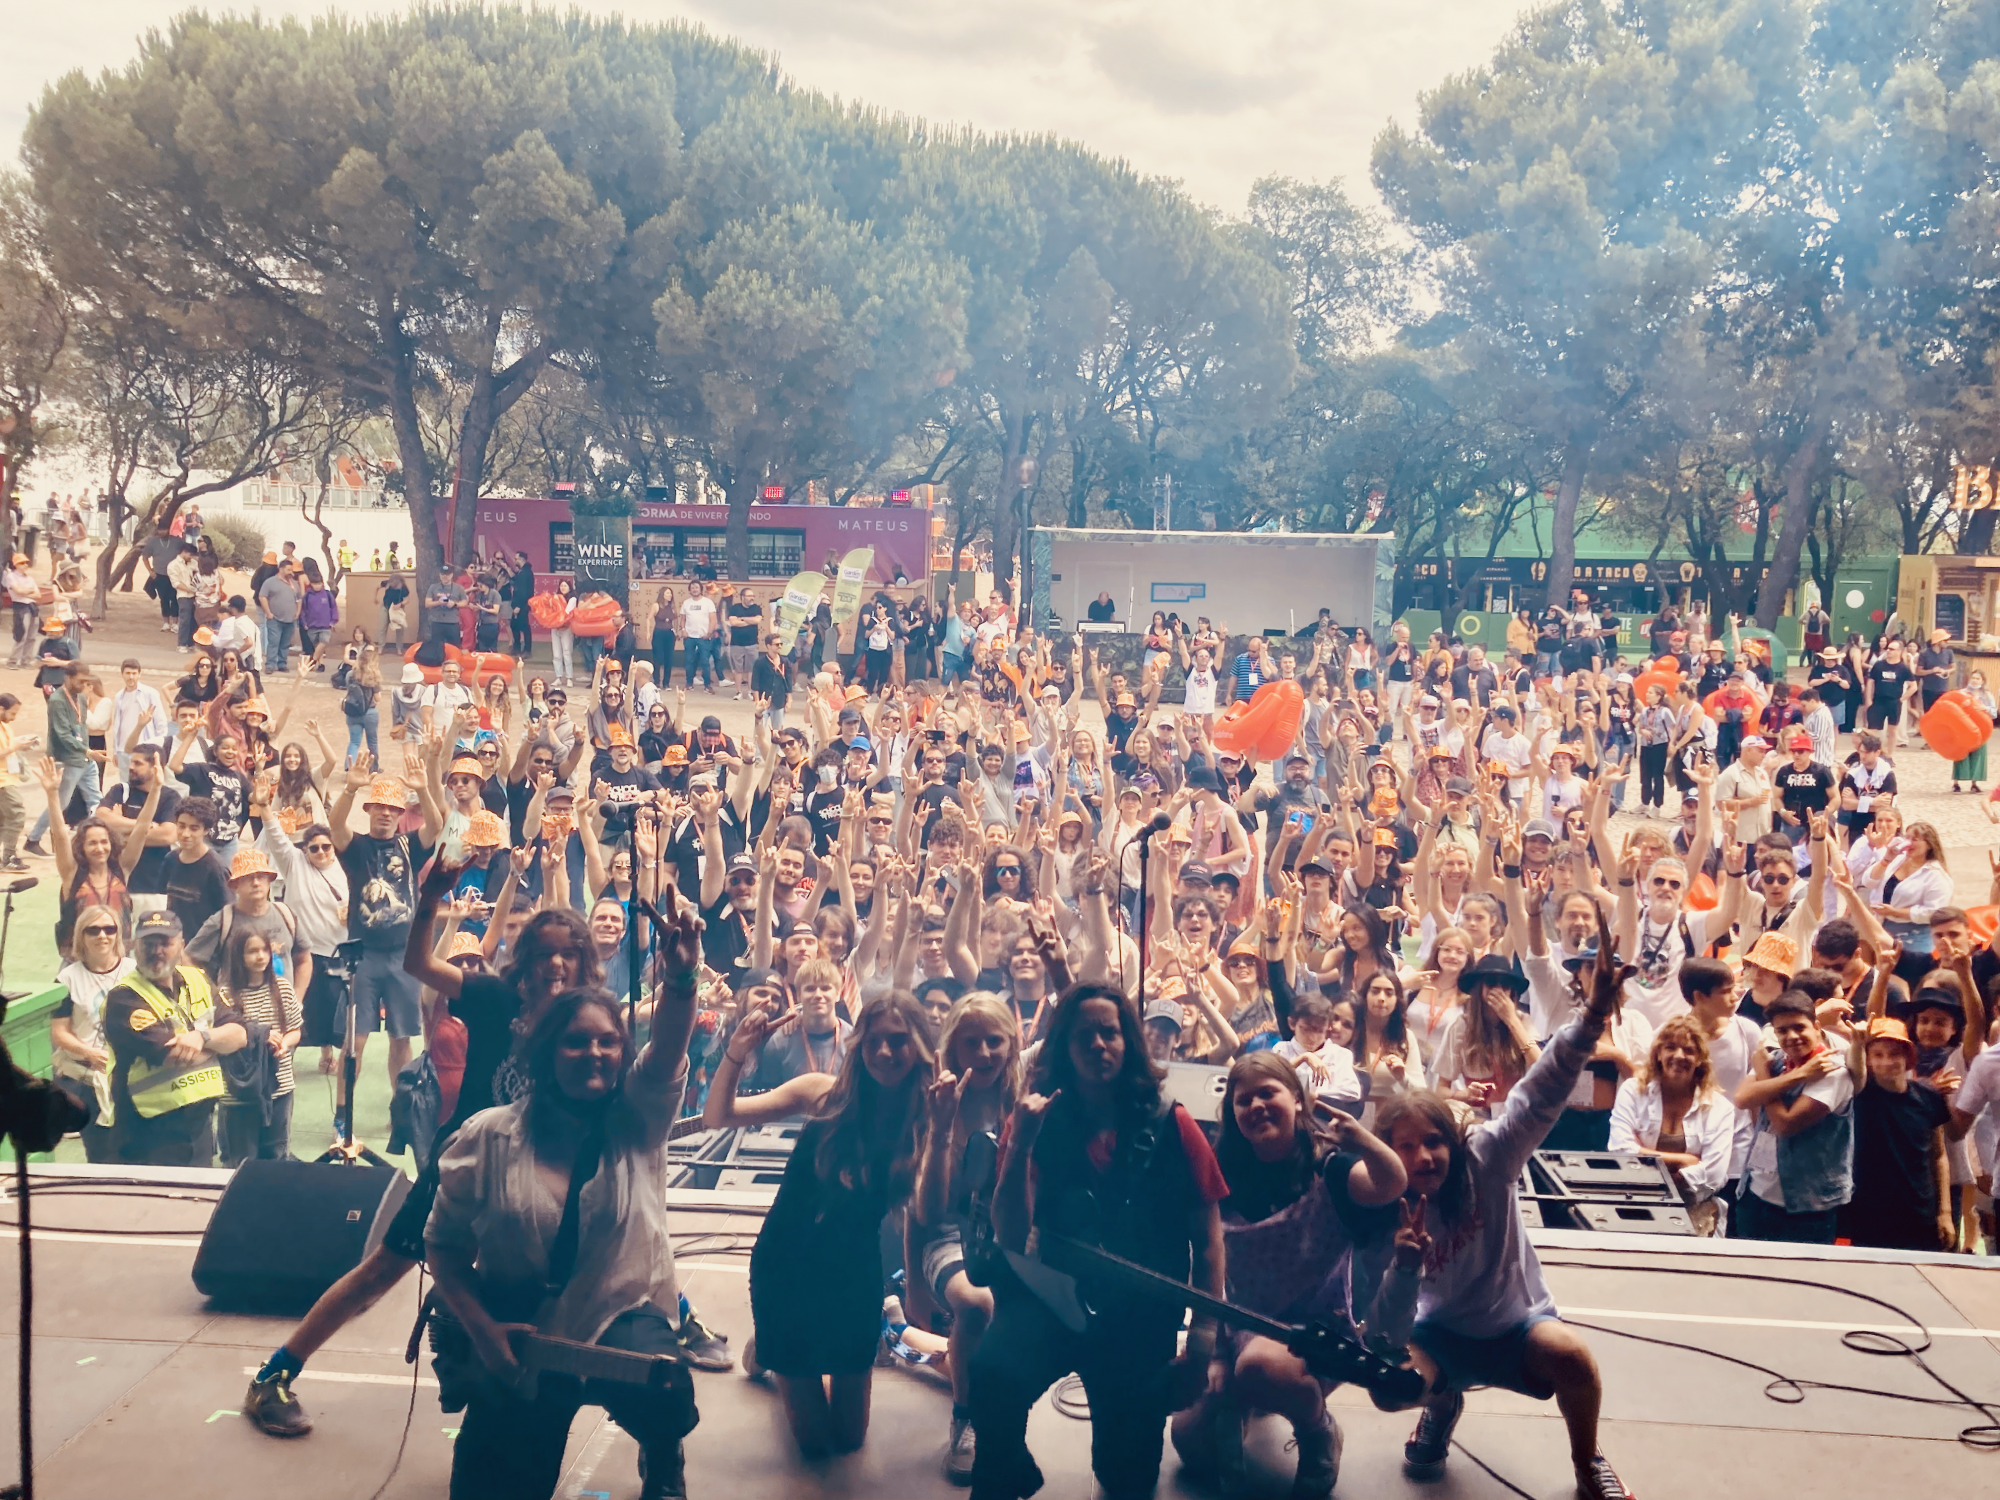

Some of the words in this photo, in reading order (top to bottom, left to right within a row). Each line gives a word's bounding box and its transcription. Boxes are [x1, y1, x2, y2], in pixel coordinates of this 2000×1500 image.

[640, 508, 678, 518] ORMA
[681, 511, 693, 519] DE
[695, 511, 722, 520] VIVER
[749, 513, 771, 521] NDO
[838, 520, 909, 532] MATEUS
[577, 544, 623, 558] WINE
[577, 558, 623, 566] EXPERIENCE
[1596, 566, 1630, 578] TACO
